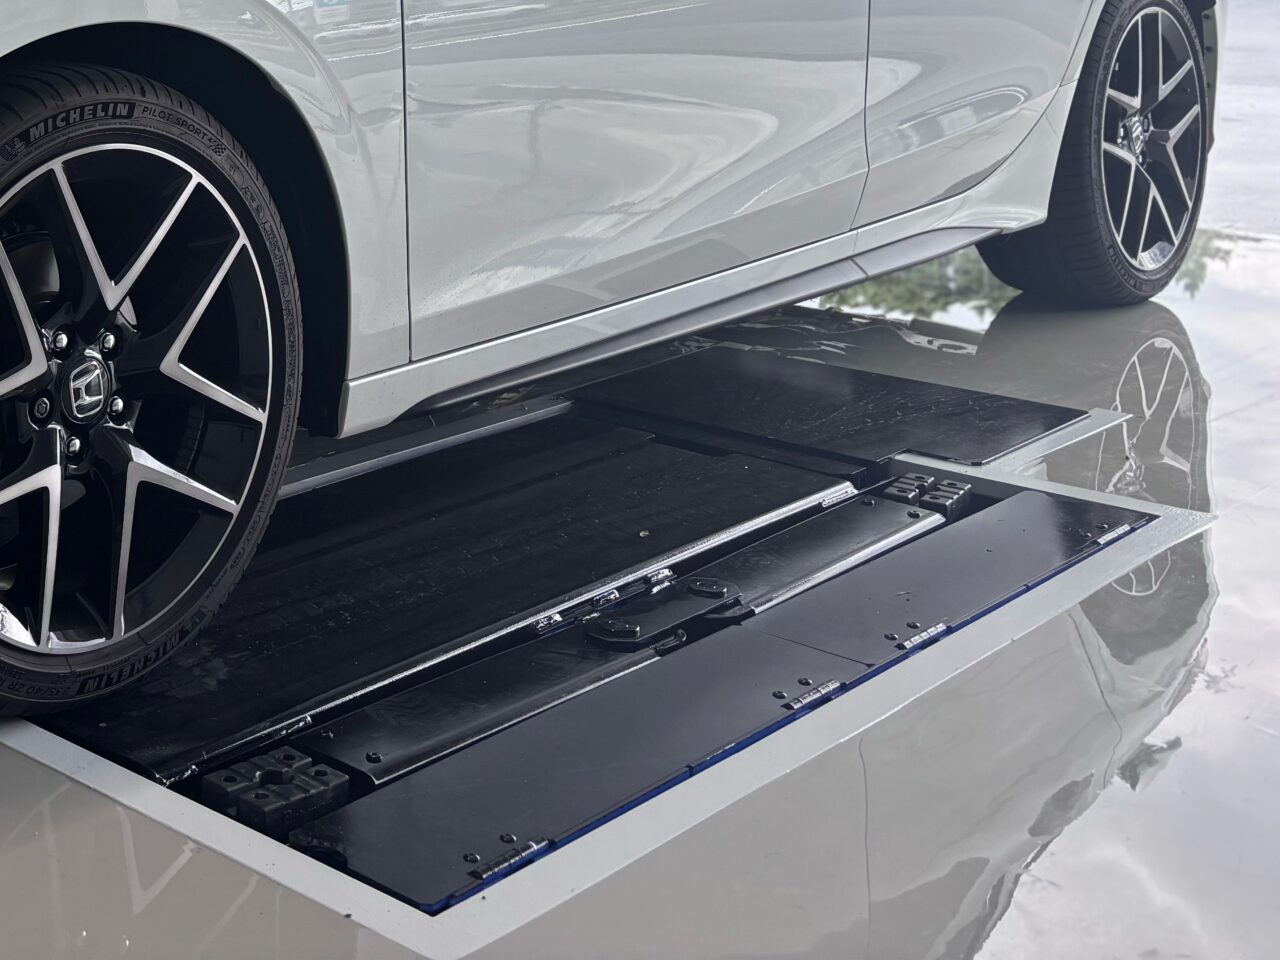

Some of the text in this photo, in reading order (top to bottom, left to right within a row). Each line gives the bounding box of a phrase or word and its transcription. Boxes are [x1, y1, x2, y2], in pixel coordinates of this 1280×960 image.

[30, 103, 130, 142] MICHELIN
[142, 106, 173, 121] PILOT
[175, 117, 210, 140] SPORT
[83, 628, 180, 694] MICHELIN
